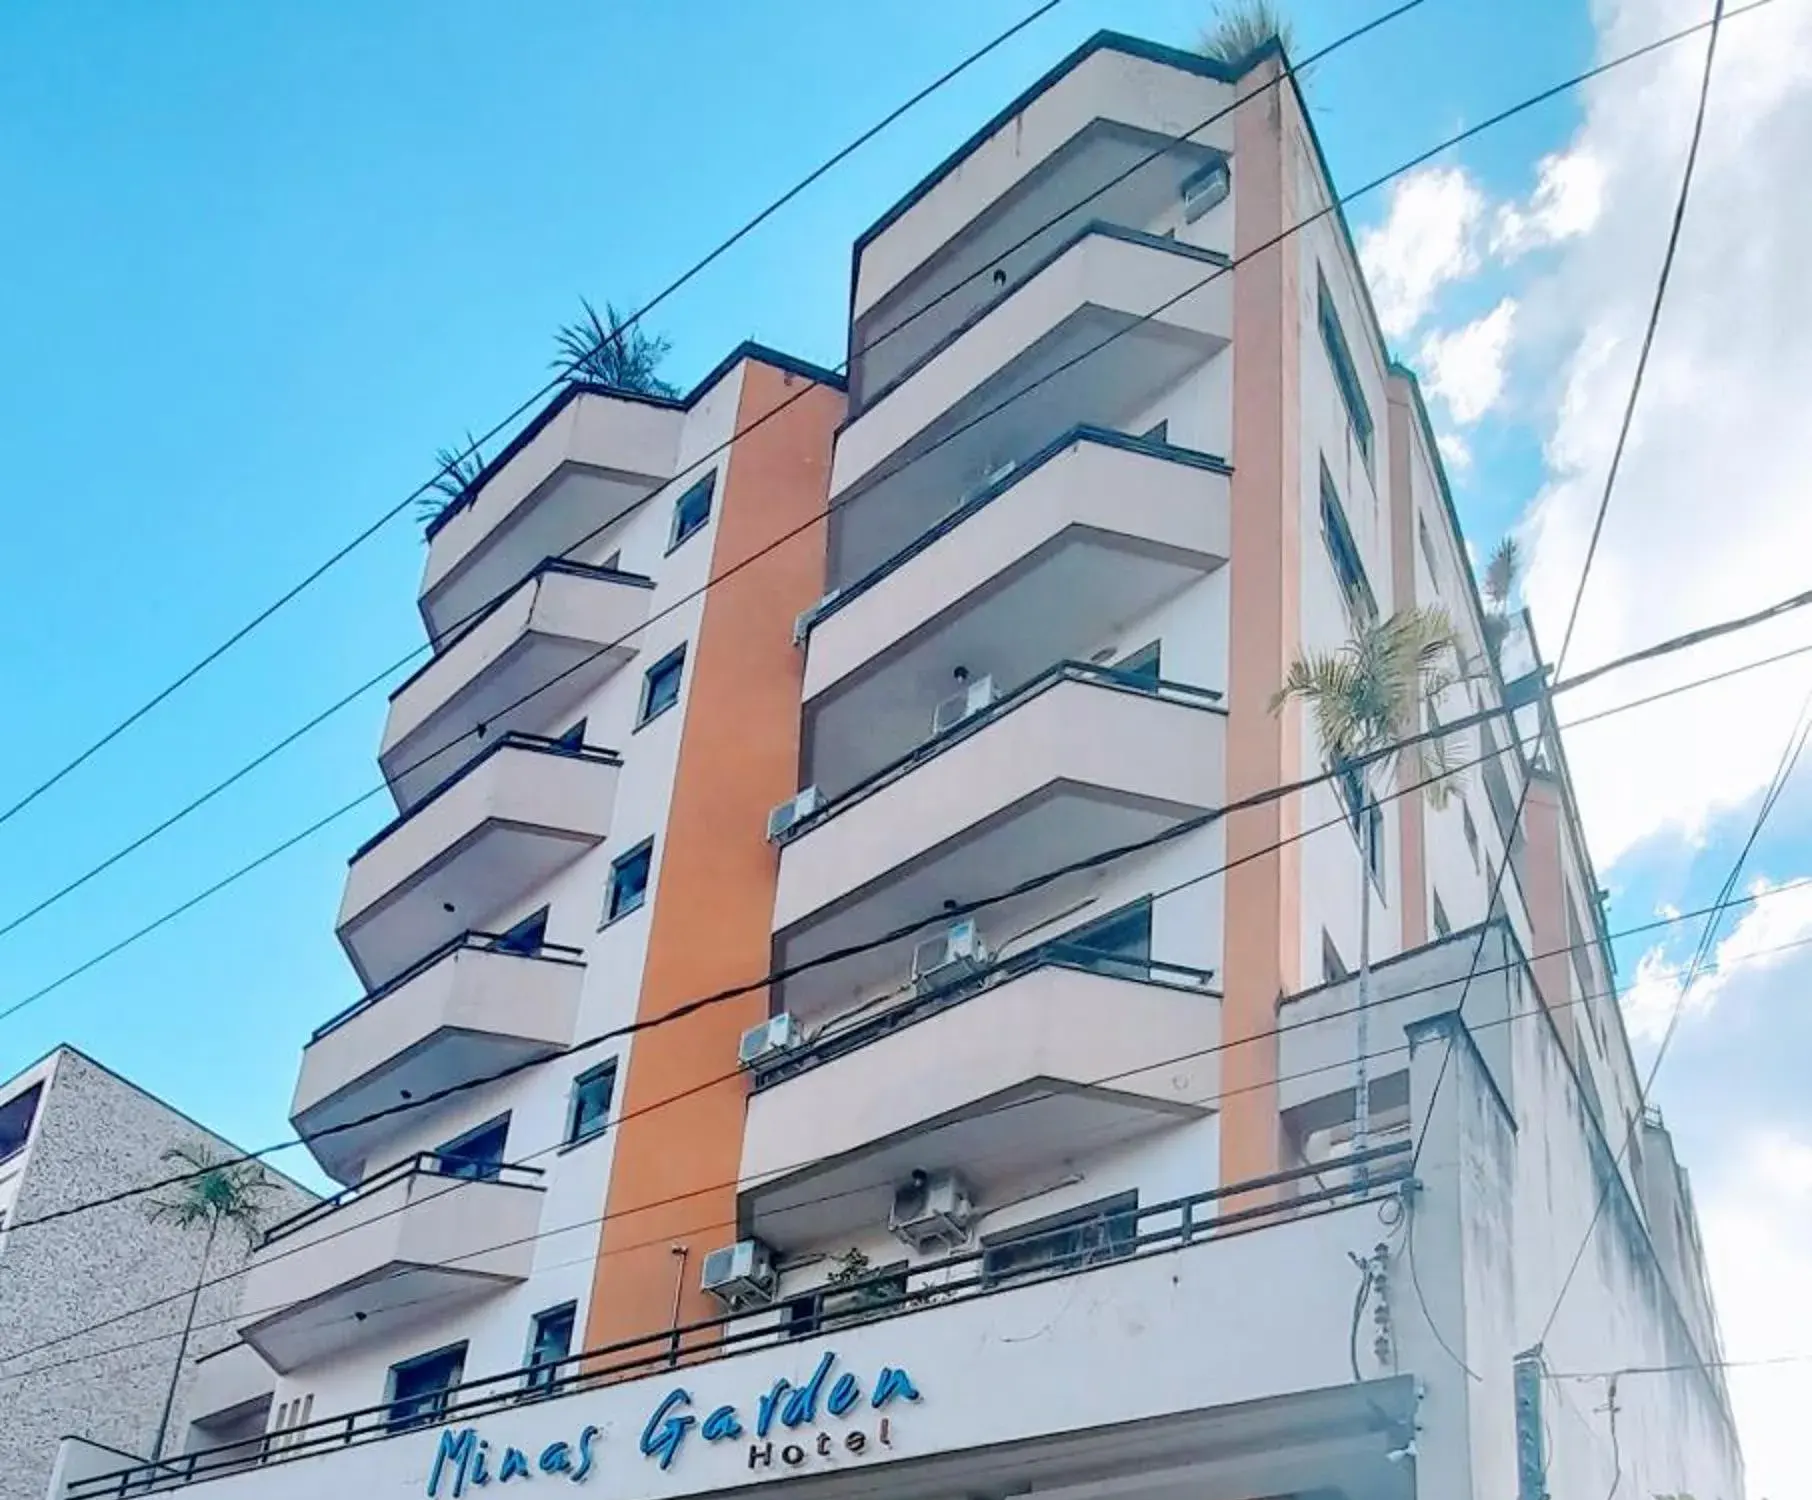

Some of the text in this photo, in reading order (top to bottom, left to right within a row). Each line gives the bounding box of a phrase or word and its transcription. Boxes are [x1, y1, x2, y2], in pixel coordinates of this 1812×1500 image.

[427, 1351, 920, 1498] Minas Garden
[747, 1419, 893, 1469] Hotel
